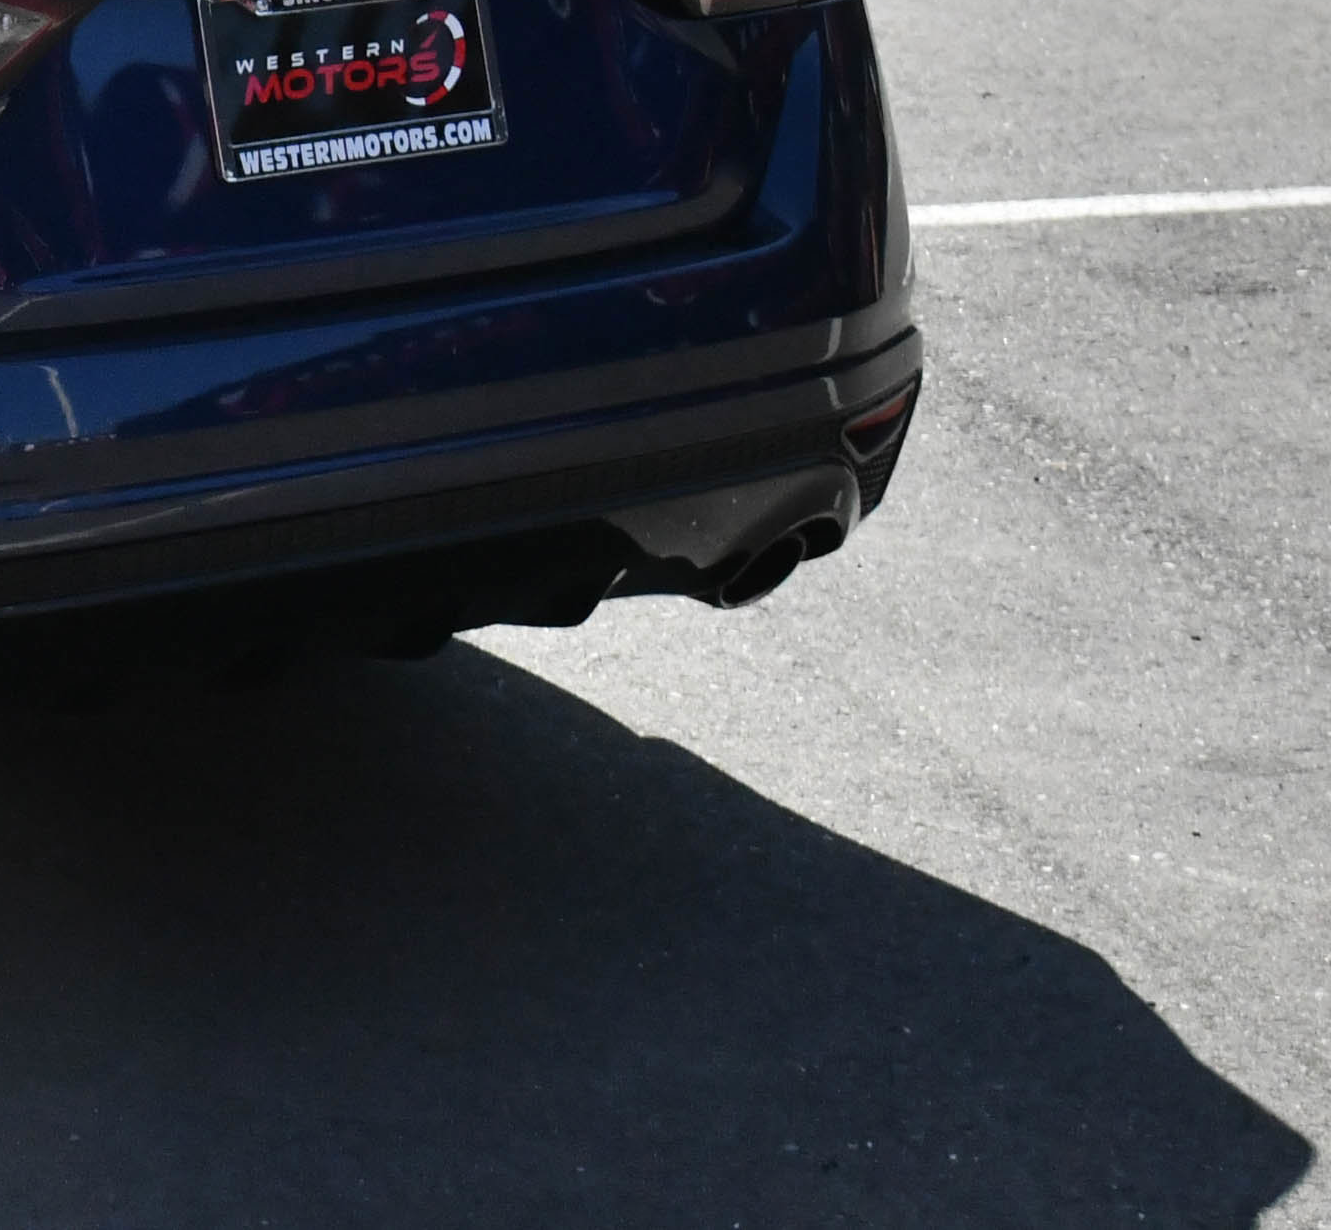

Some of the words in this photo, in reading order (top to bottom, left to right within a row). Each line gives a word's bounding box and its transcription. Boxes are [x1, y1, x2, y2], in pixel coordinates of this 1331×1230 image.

[235, 38, 406, 75] WESTERN
[244, 51, 441, 106] MOTORS
[240, 118, 492, 175] WESTERNMOTORS.COM
